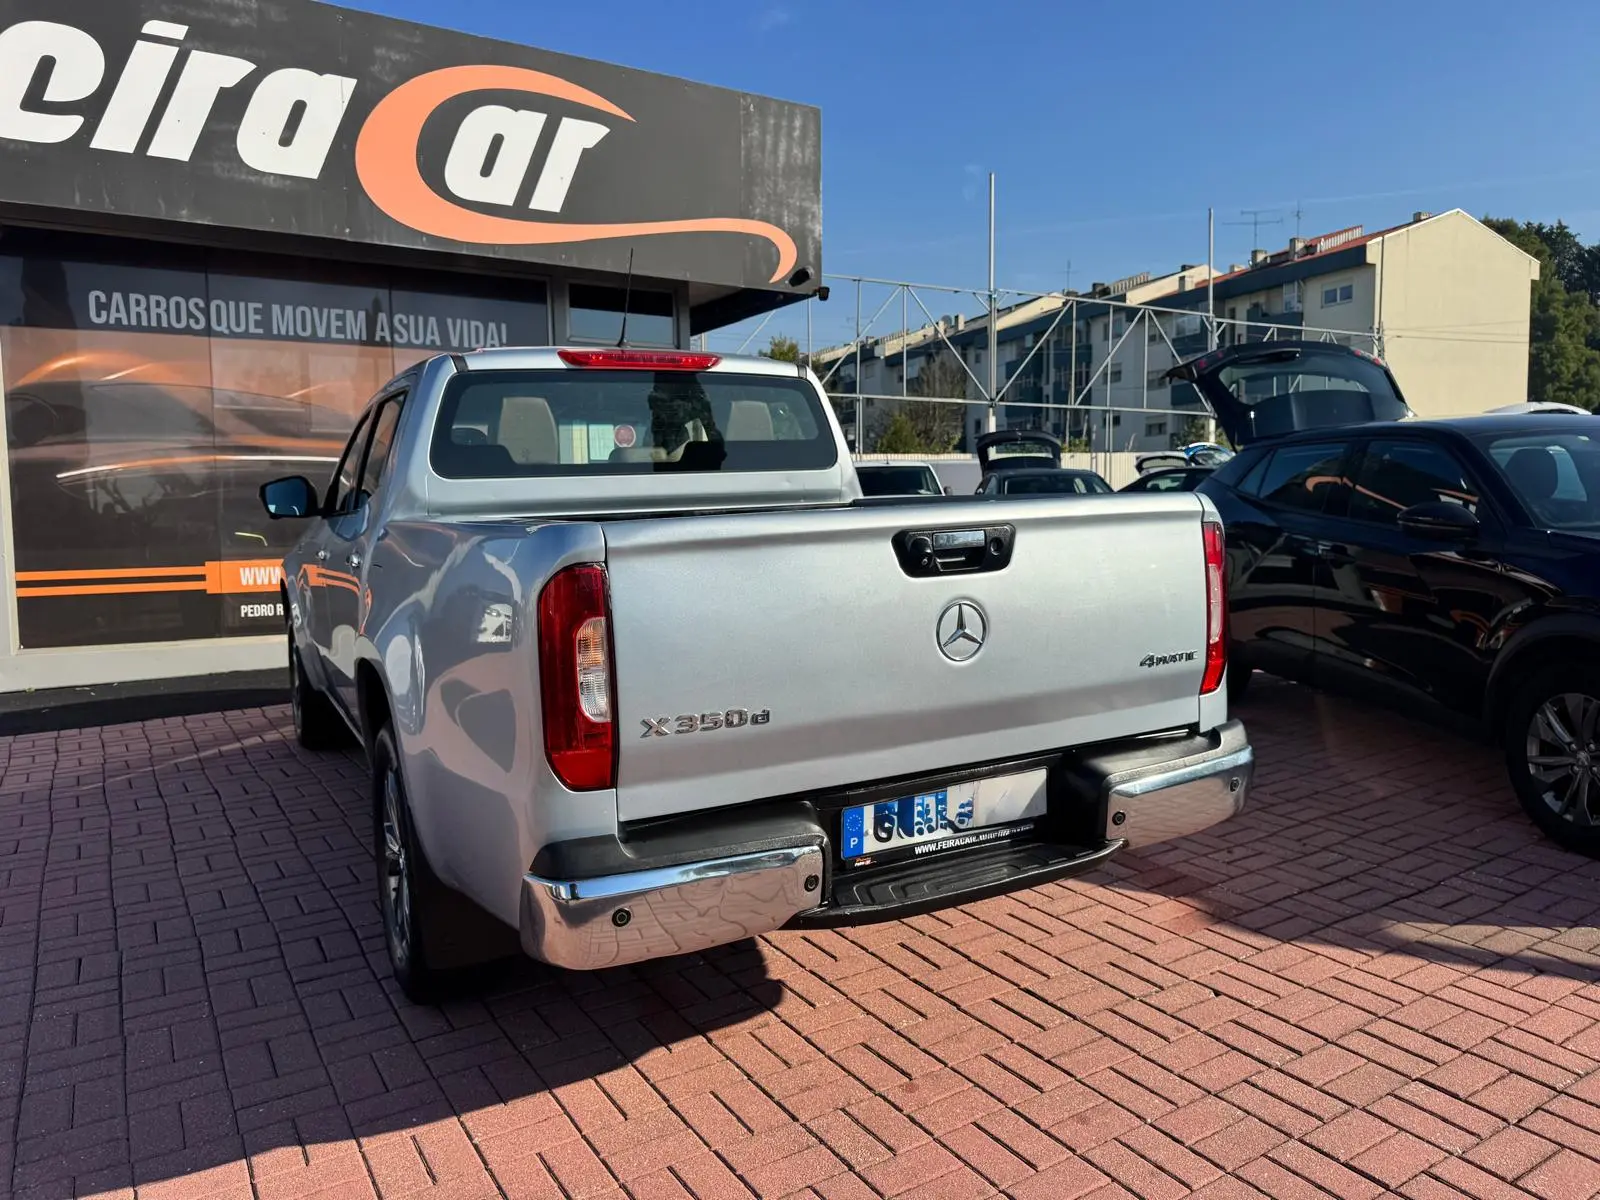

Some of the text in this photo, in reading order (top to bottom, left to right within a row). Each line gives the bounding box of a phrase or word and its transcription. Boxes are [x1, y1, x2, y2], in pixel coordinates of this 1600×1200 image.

[88, 290, 507, 348] CARROS QUE MOVEM A SUA VIDA!
[241, 604, 274, 617] PEDRO
[850, 837, 859, 849] P
